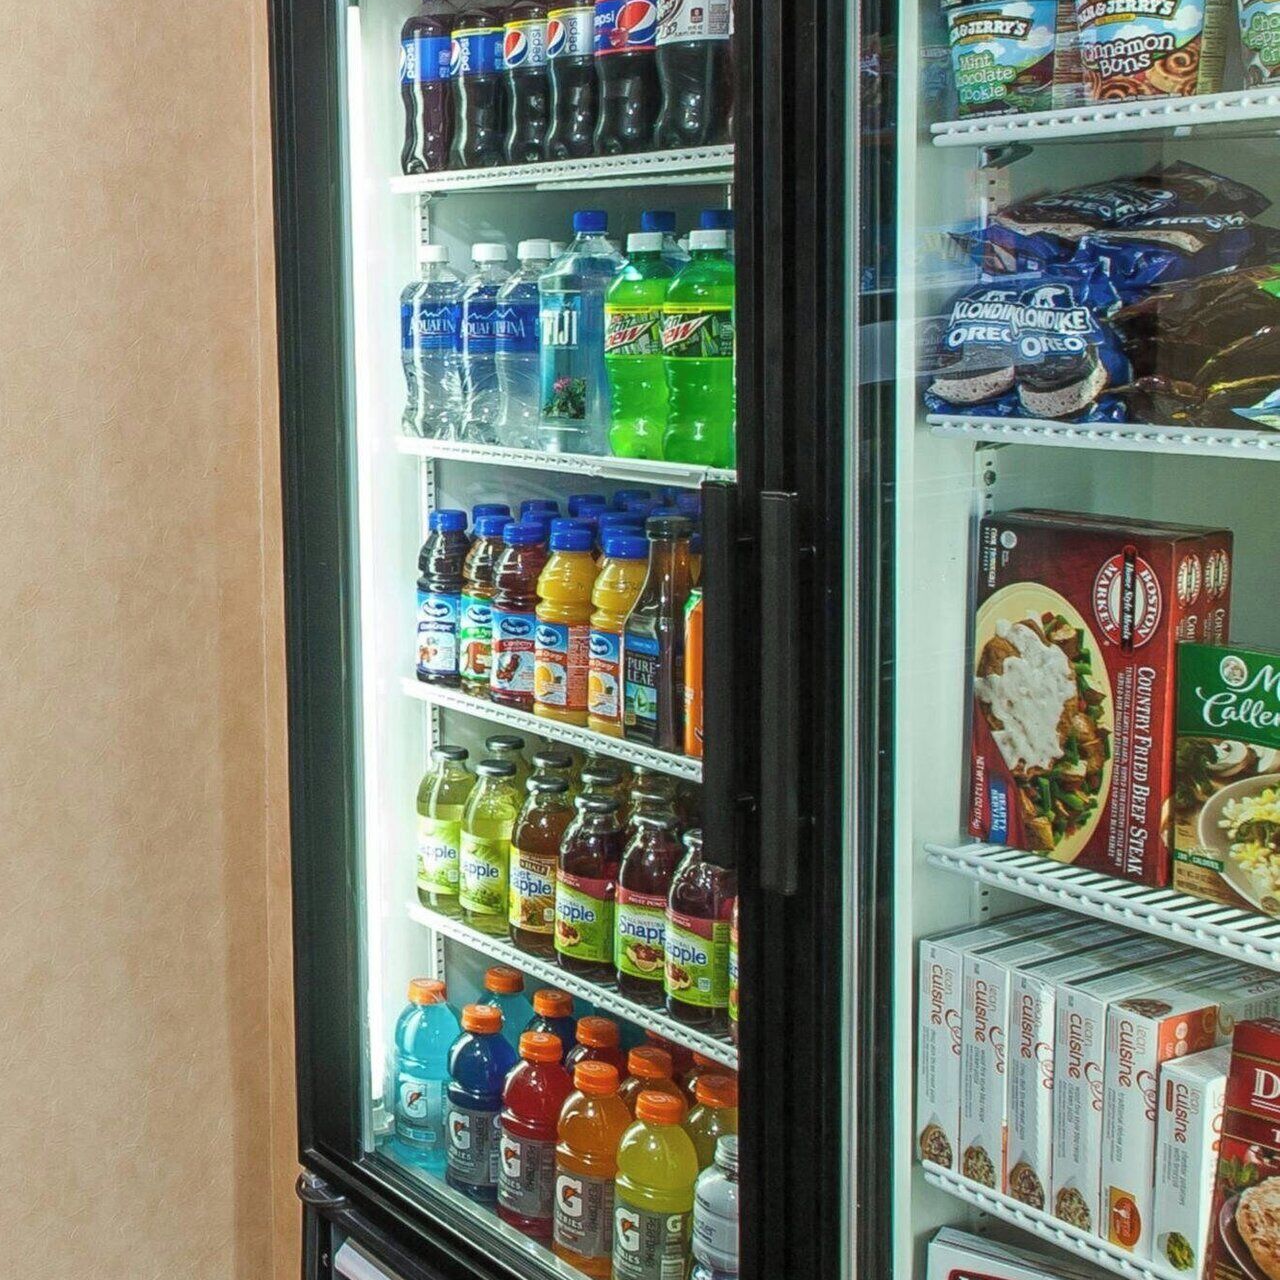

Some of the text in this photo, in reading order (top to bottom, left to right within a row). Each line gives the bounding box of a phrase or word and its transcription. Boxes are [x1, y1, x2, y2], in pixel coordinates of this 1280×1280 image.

[541, 310, 579, 346] FIJI
[1021, 336, 1084, 356] OREO
[1096, 564, 1119, 634] MARKET
[1138, 569, 1161, 637] BOSTON
[627, 656, 655, 672] PURE
[627, 671, 653, 686] LEAF
[1127, 666, 1156, 876] COUNTRY FRIED BEEF STEAK
[931, 964, 944, 1025] cuisine
[975, 980, 988, 1042] cuisine
[1022, 995, 1035, 1058] cuisine
[1069, 1013, 1084, 1079] cuisine
[1119, 1020, 1135, 1087] cuisine
[1175, 1084, 1192, 1144] cuisine
